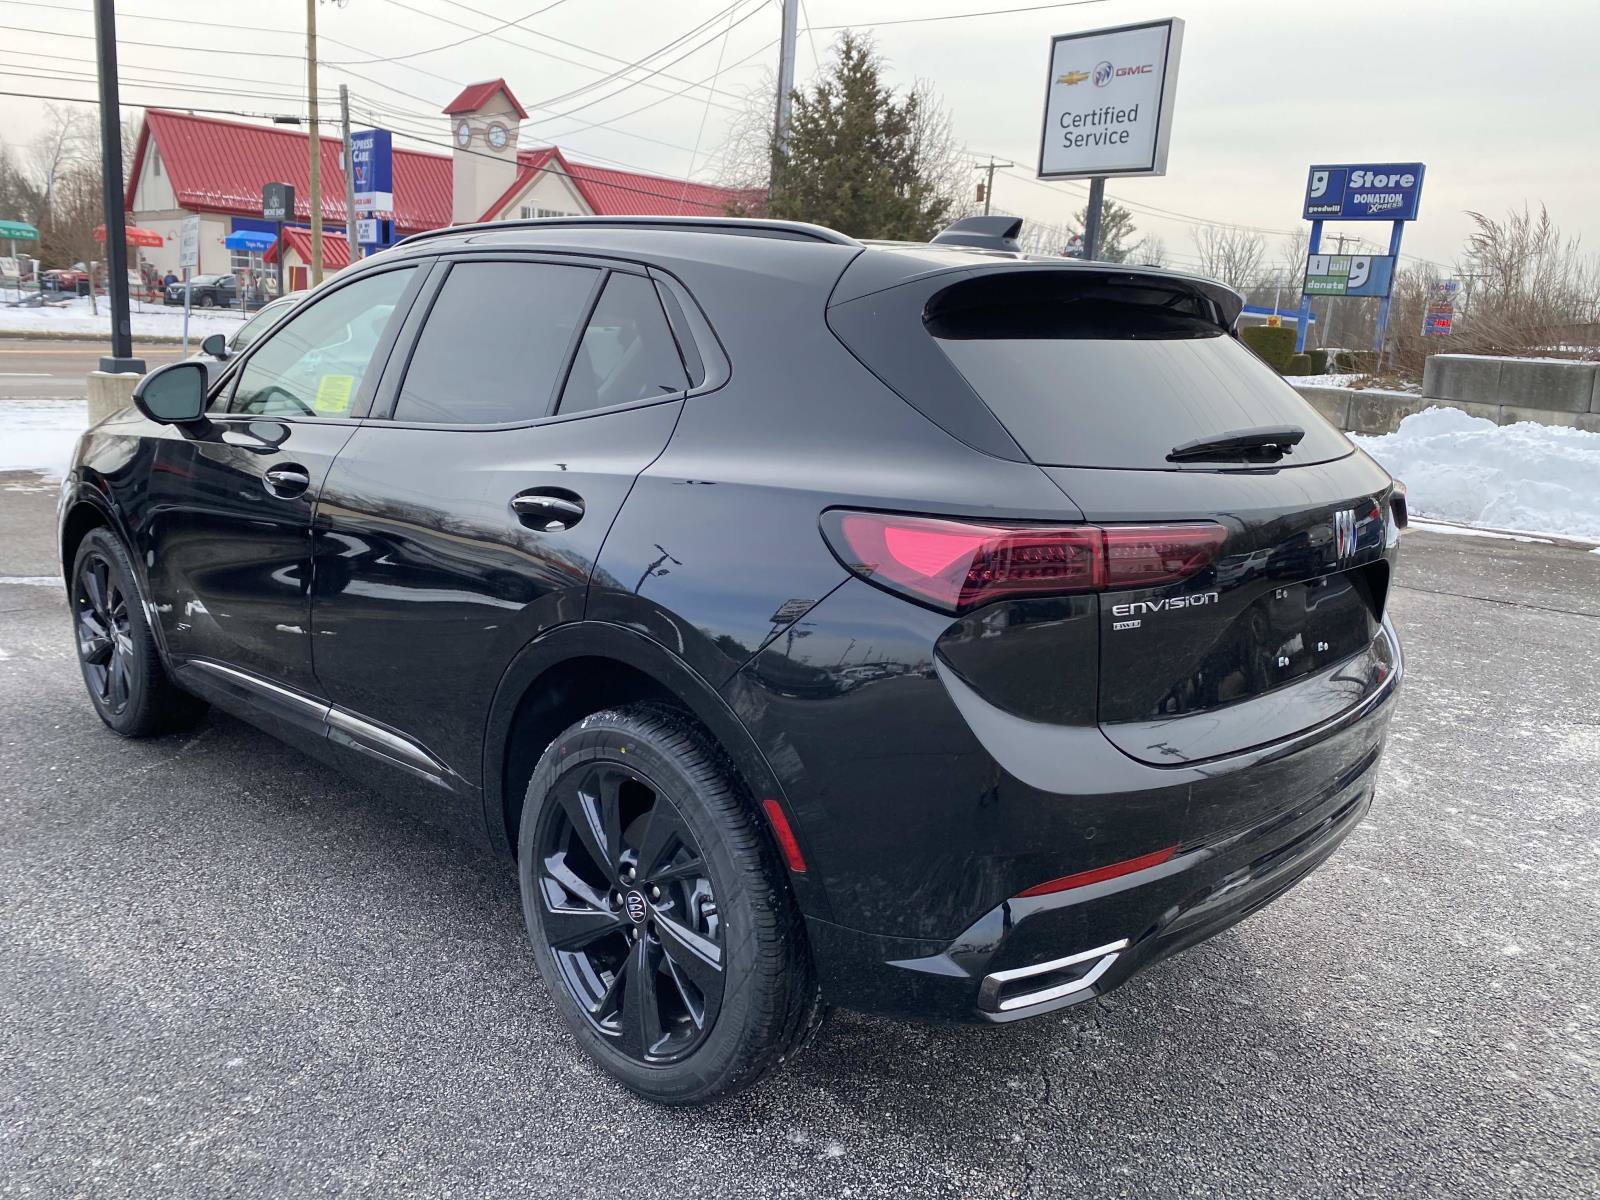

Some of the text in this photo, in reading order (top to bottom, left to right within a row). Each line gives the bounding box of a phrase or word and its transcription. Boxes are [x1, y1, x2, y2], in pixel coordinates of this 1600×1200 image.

[1116, 65, 1153, 77] GMC
[1060, 103, 1139, 129] Certified
[1063, 128, 1130, 149] Service
[1349, 171, 1415, 188] Store
[1354, 193, 1403, 204] DONATION
[1309, 205, 1340, 213] goodwill
[1307, 280, 1345, 290] donate
[1431, 281, 1456, 291] Mobil
